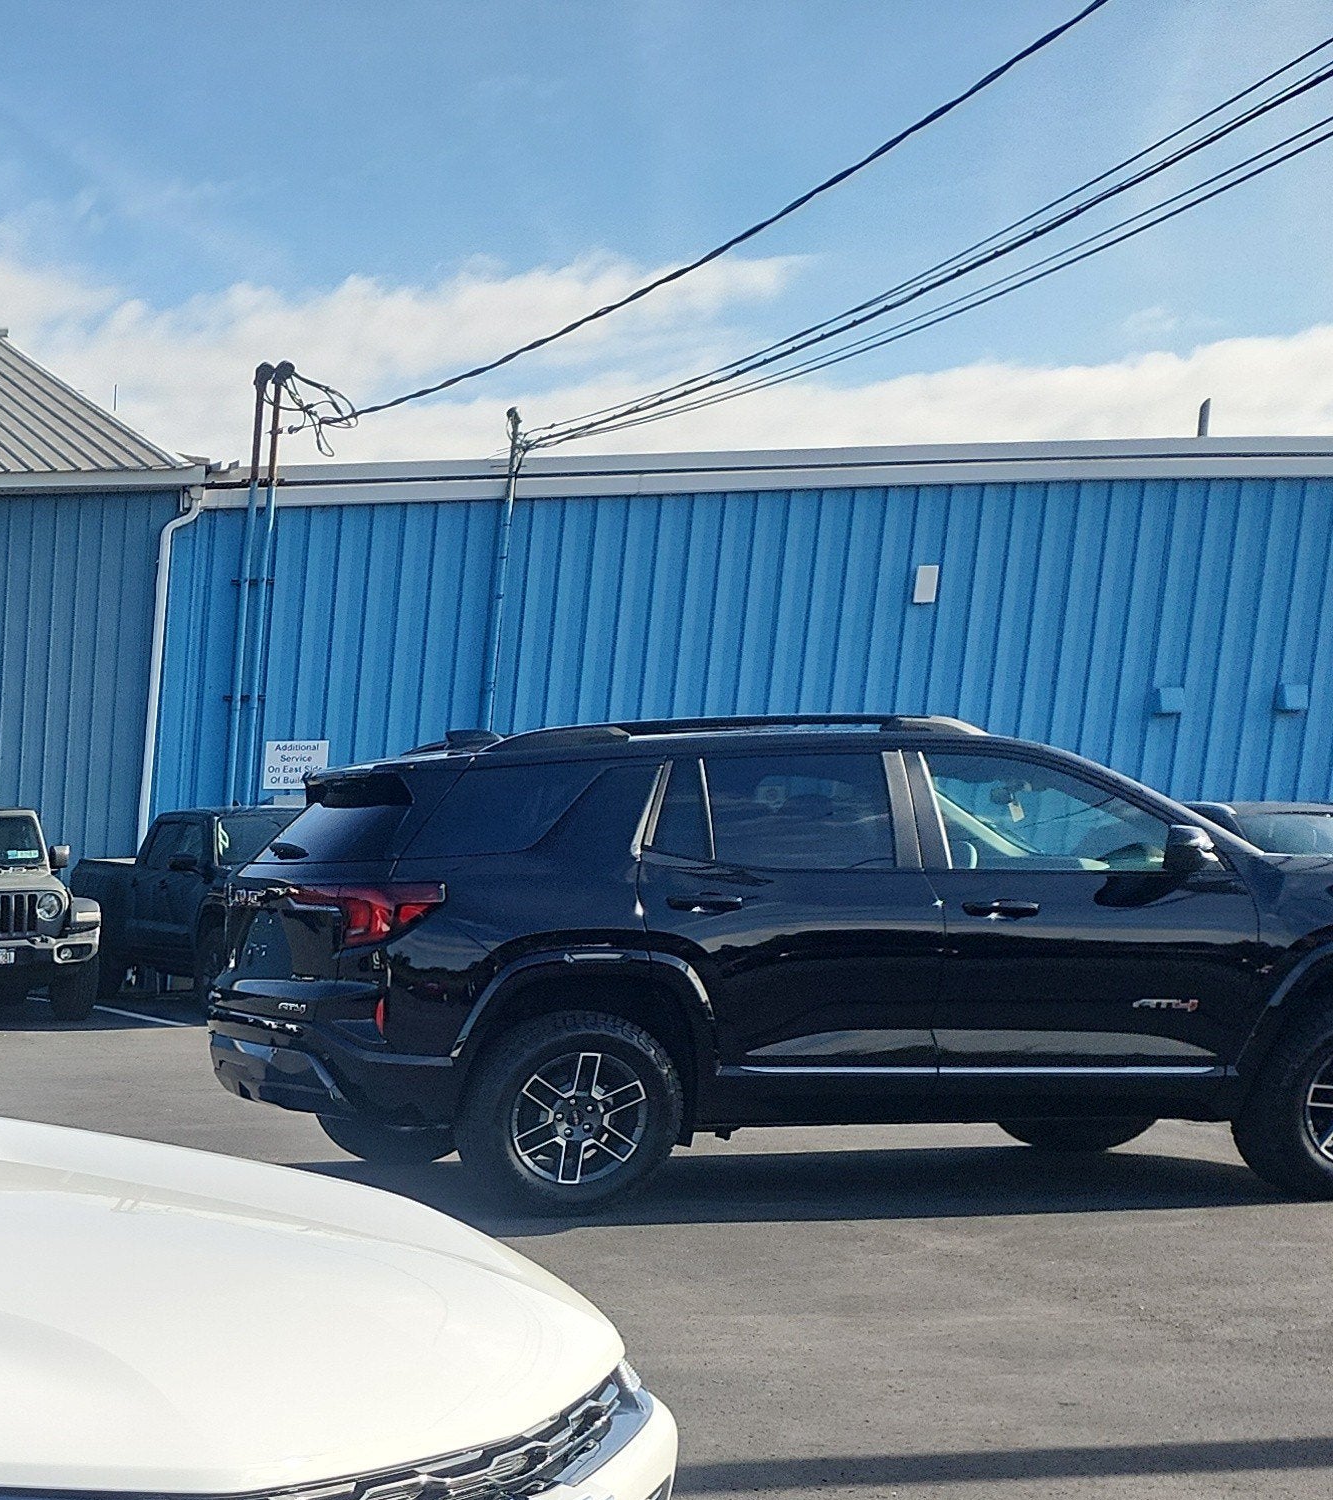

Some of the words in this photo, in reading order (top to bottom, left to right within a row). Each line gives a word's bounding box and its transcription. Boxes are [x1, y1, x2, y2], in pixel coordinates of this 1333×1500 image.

[275, 743, 319, 751] Additional
[280, 754, 313, 763] Service
[268, 765, 281, 774] On
[283, 765, 303, 774] East
[270, 776, 281, 785] Of
[1132, 998, 1199, 1013] AT4
